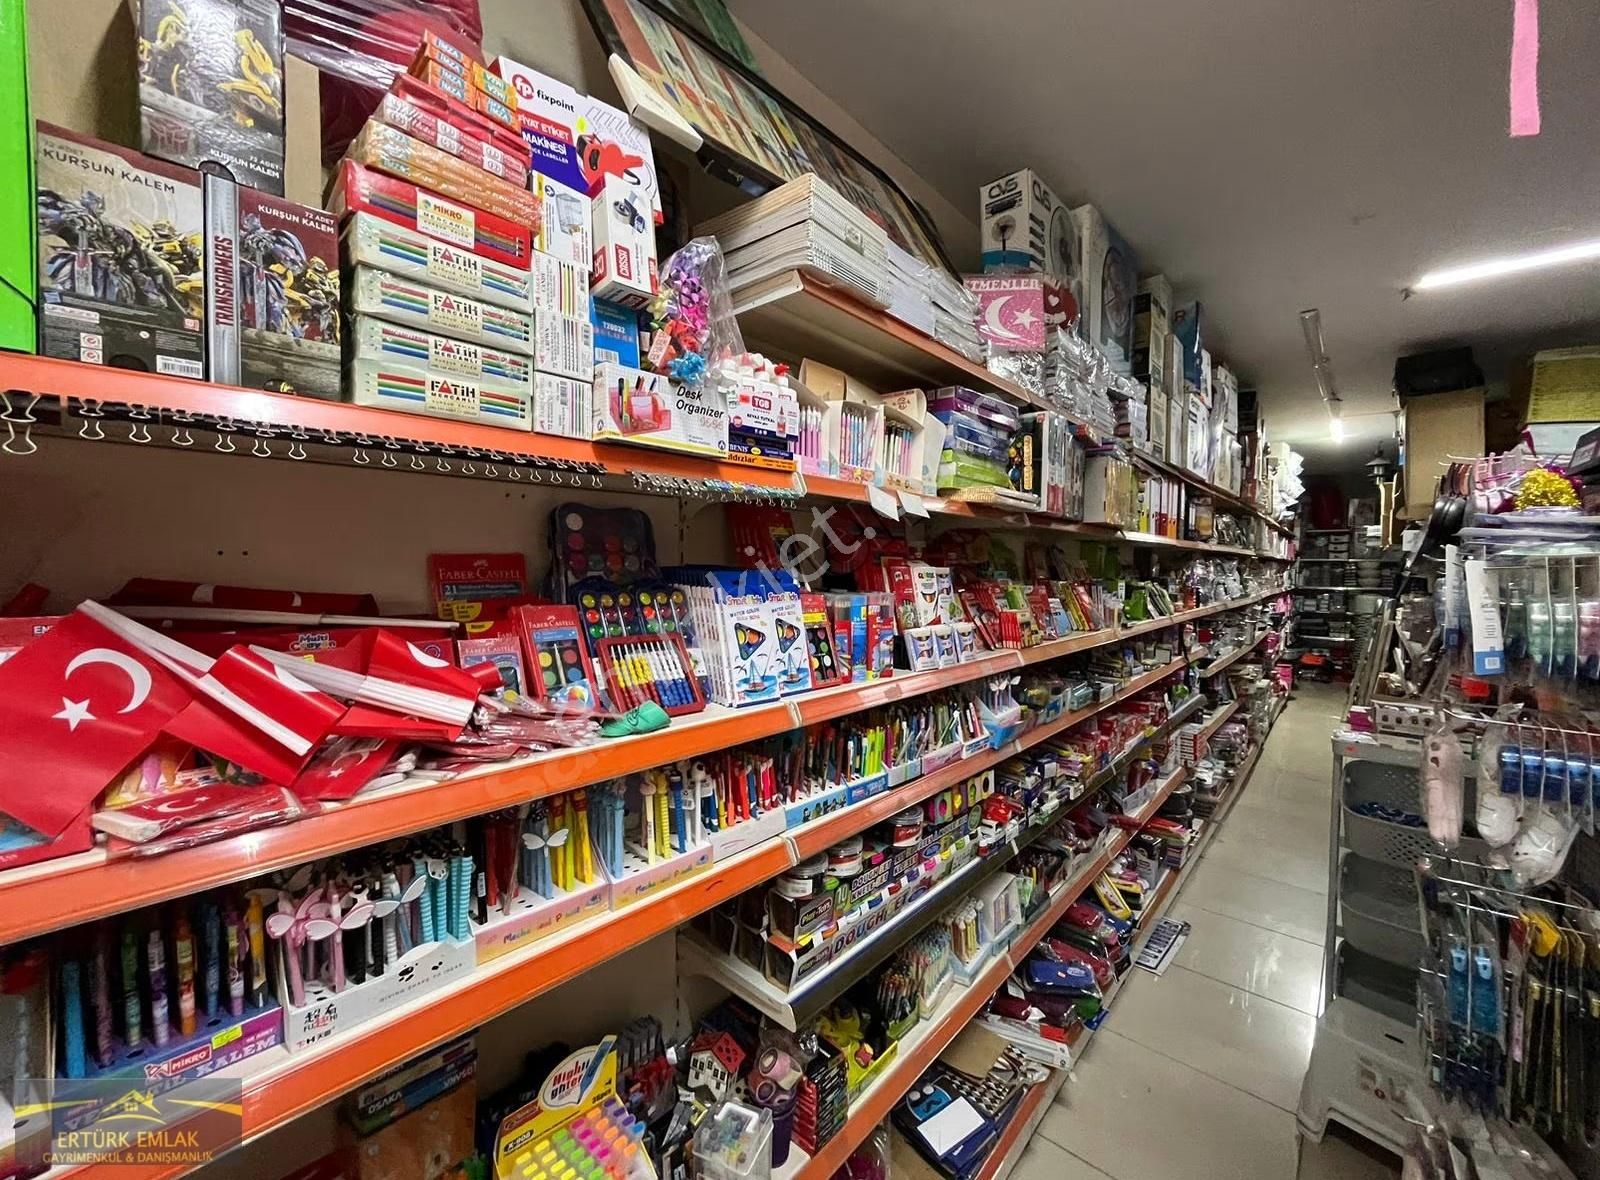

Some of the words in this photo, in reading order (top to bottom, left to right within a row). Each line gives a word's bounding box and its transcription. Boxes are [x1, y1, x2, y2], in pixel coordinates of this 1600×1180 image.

[537, 89, 575, 112] fixpoint
[522, 130, 567, 155] MAKİNESİ
[43, 148, 115, 176] KURŞUN
[121, 170, 175, 194] KALEM
[302, 217, 335, 234] KALEM
[315, 214, 336, 226] ADET
[215, 236, 235, 326] TRANSFORMERS
[677, 386, 703, 401] Desk
[676, 399, 724, 419] Organizer
[196, 1035, 276, 1078] KALEM
[368, 1090, 403, 1114] OSAKA
